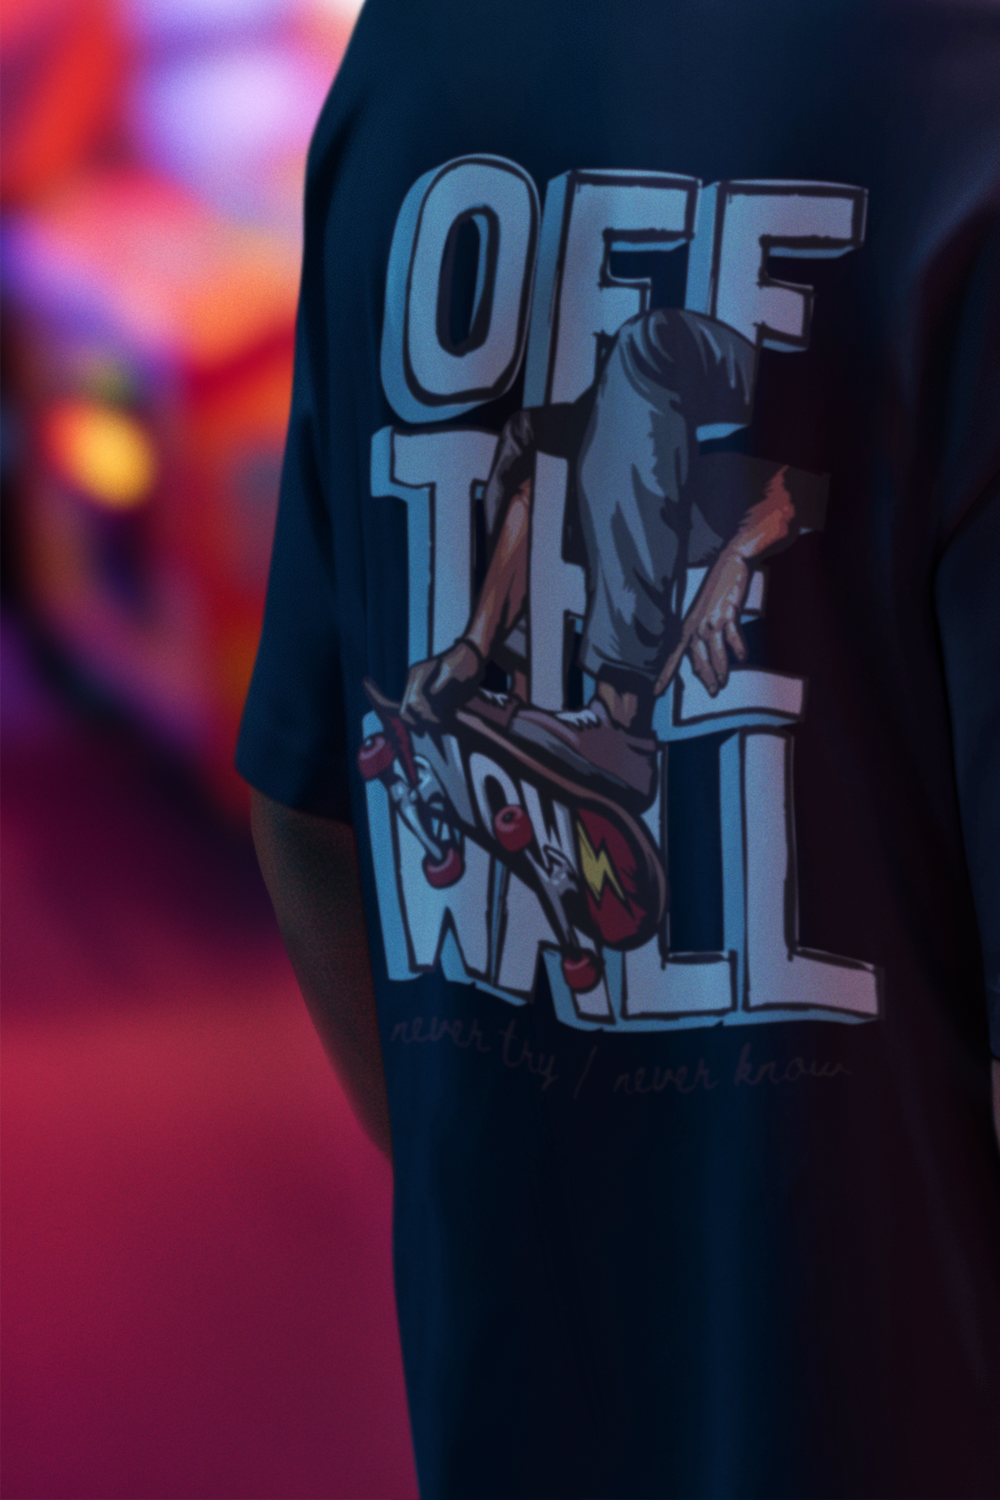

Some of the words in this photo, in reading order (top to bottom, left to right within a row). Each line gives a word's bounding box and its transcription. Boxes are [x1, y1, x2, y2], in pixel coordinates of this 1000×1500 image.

[379, 153, 868, 438] OFF
[390, 1014, 492, 1054] never
[497, 1016, 560, 1092] try
[612, 1056, 720, 1096] never
[733, 1041, 852, 1088] know
